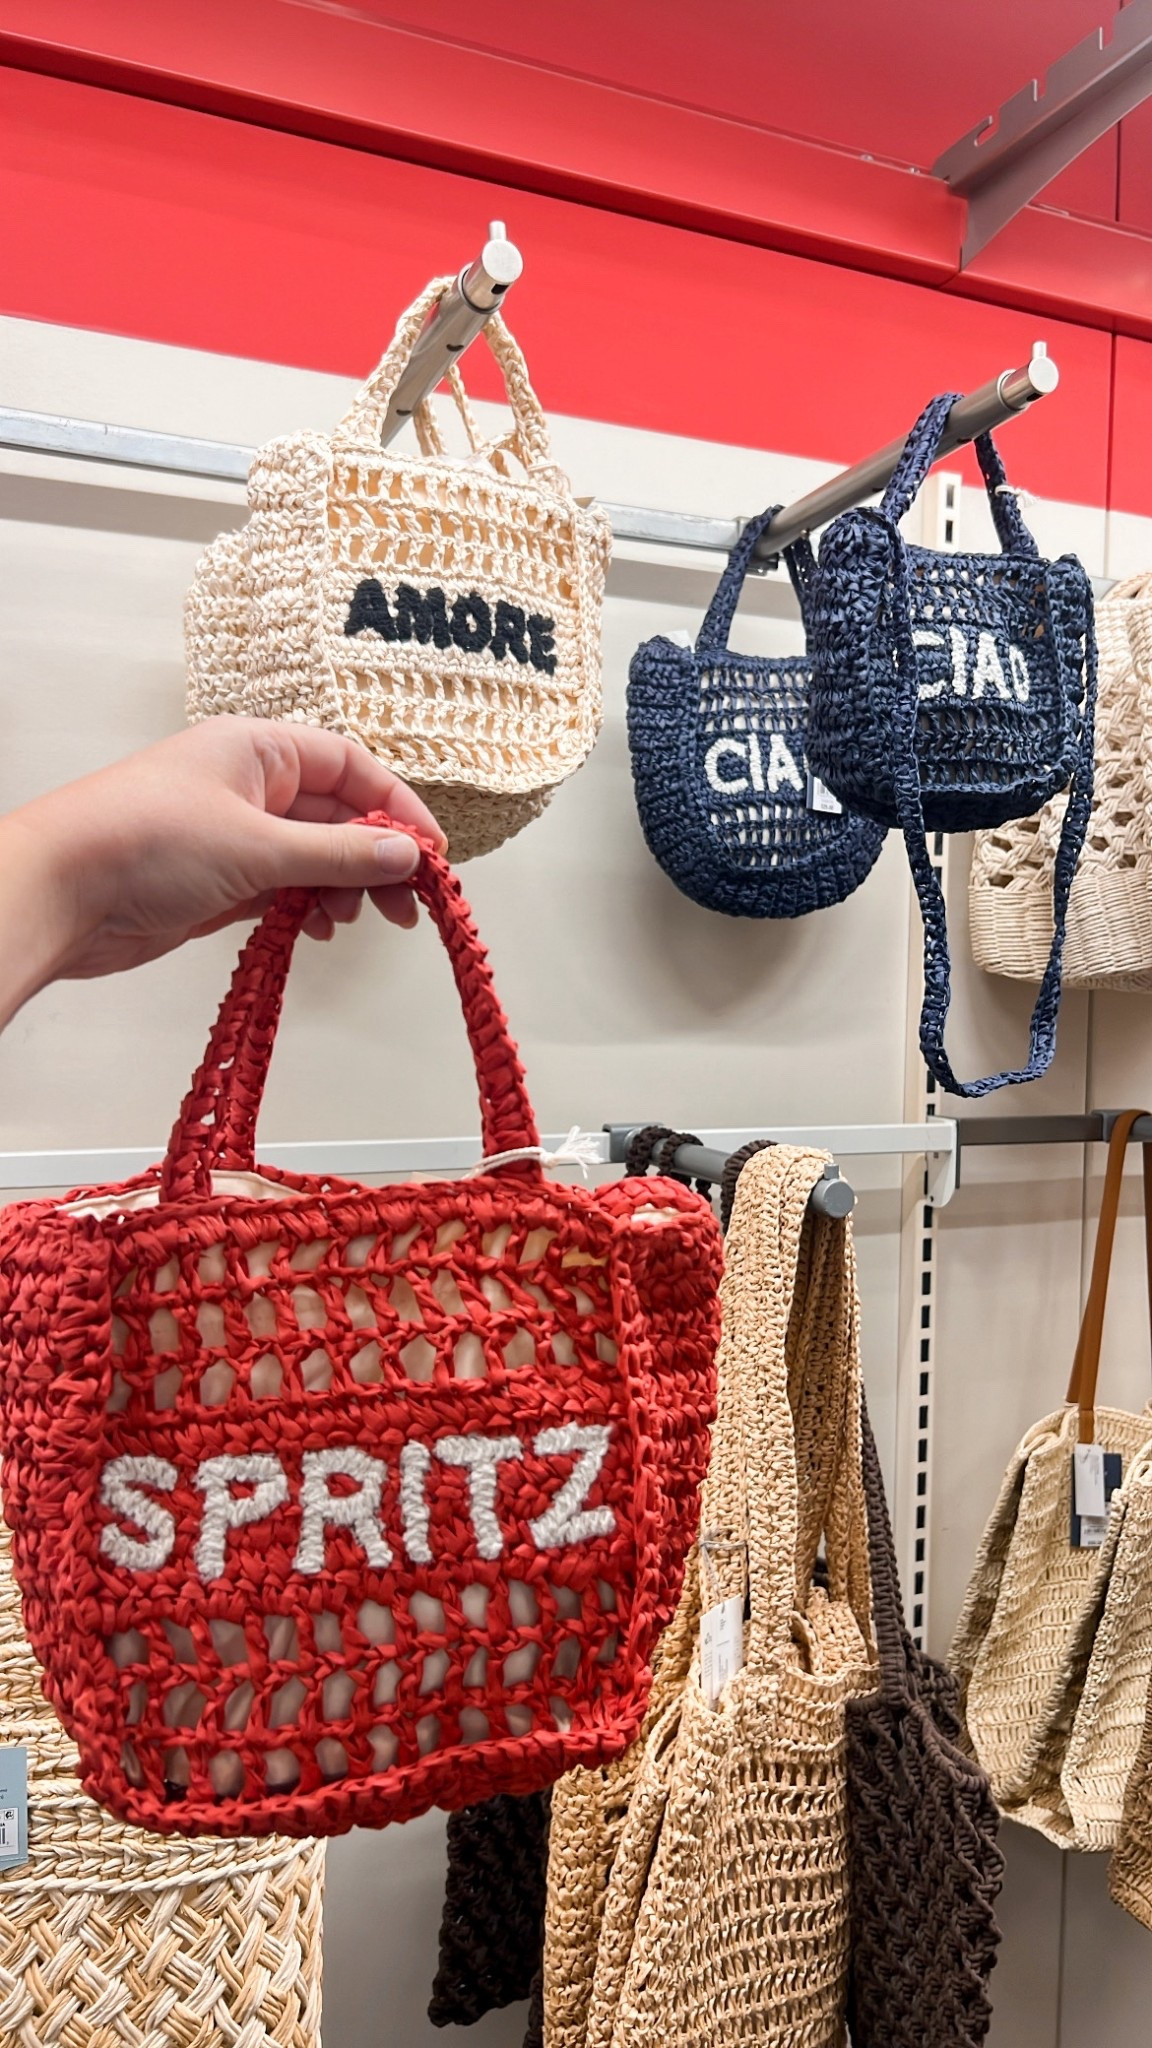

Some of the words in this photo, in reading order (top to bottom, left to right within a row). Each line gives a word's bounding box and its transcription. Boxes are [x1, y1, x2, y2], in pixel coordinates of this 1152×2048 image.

[344, 578, 557, 676] AMORE
[704, 732, 807, 795] CIA
[101, 1421, 616, 1580] SPRITZ
